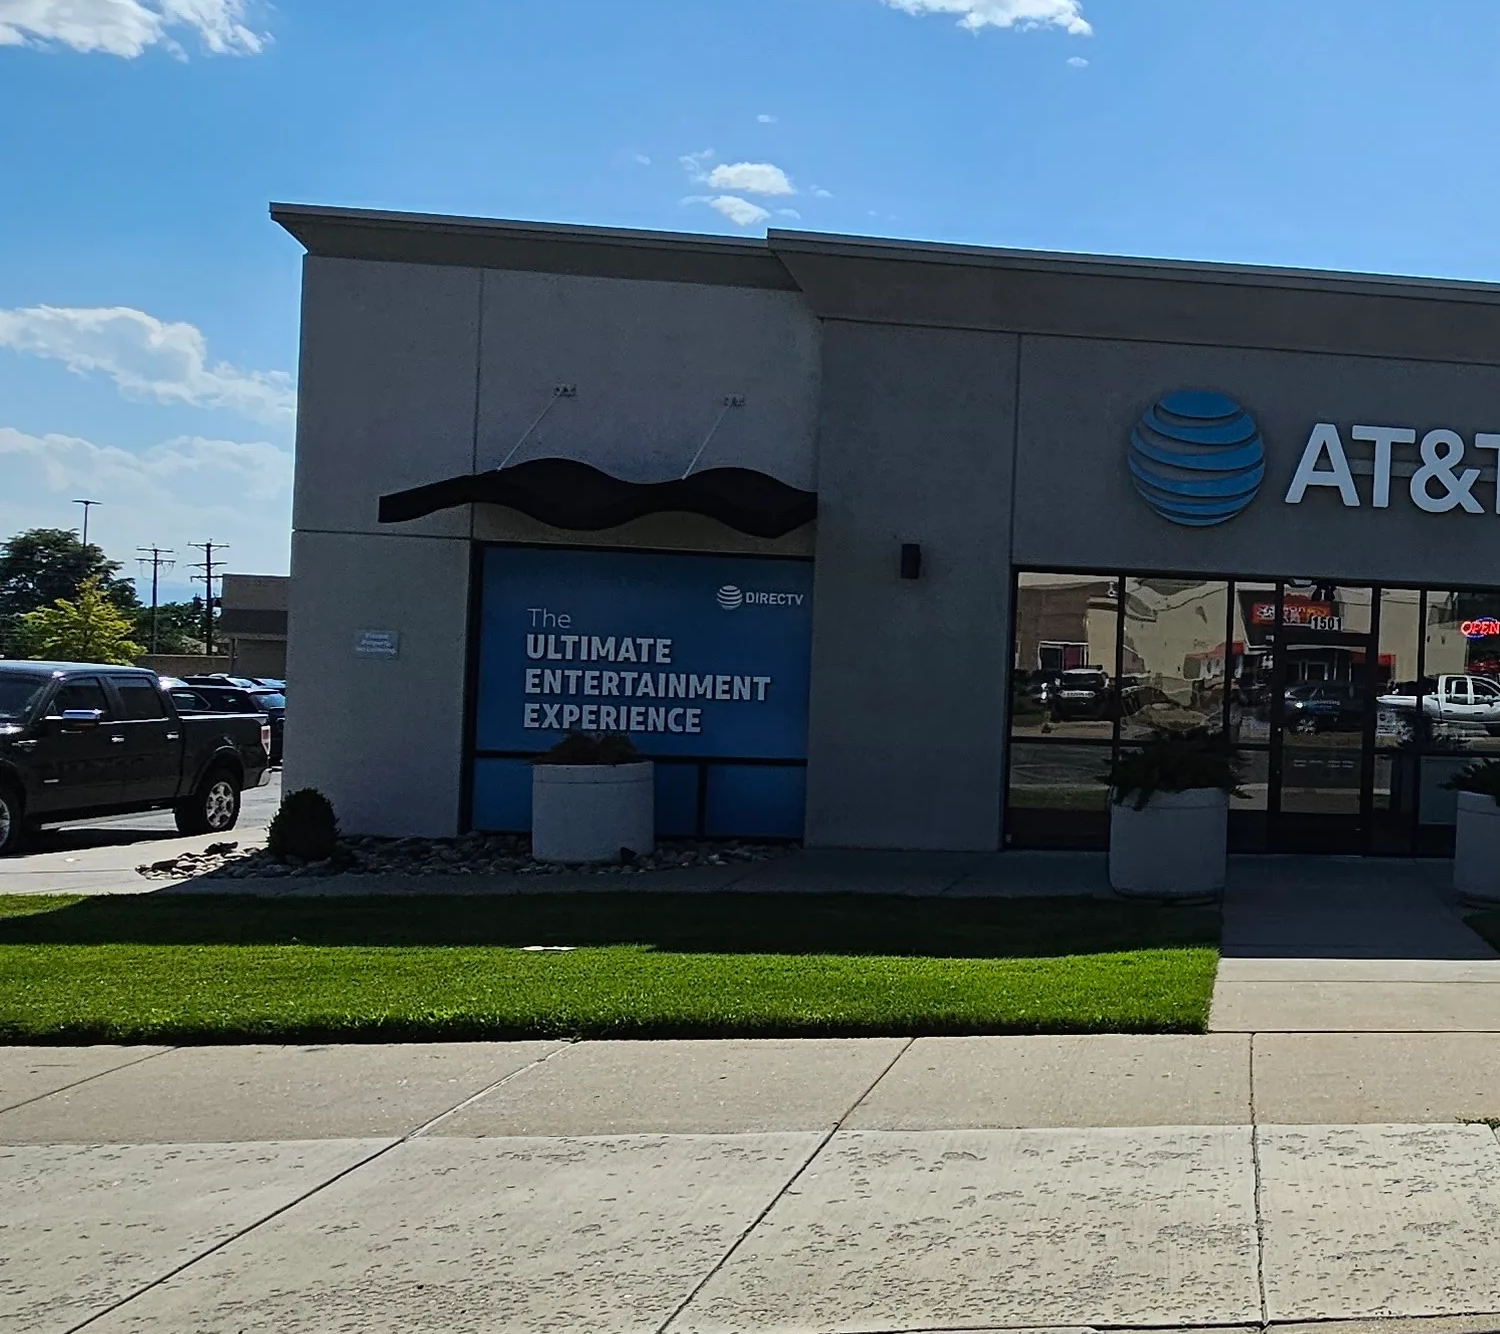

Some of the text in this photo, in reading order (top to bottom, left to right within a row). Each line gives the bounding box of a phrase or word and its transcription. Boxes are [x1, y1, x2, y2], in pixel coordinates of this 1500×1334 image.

[745, 591, 804, 607] DIRECTV
[527, 608, 572, 629] The
[1312, 616, 1342, 631] 1501
[1461, 620, 1500, 635] OPEN
[526, 633, 672, 664] ULTIMATE
[524, 668, 771, 701] ENTERTAINMENT
[523, 703, 702, 733] EXPERIENCE
